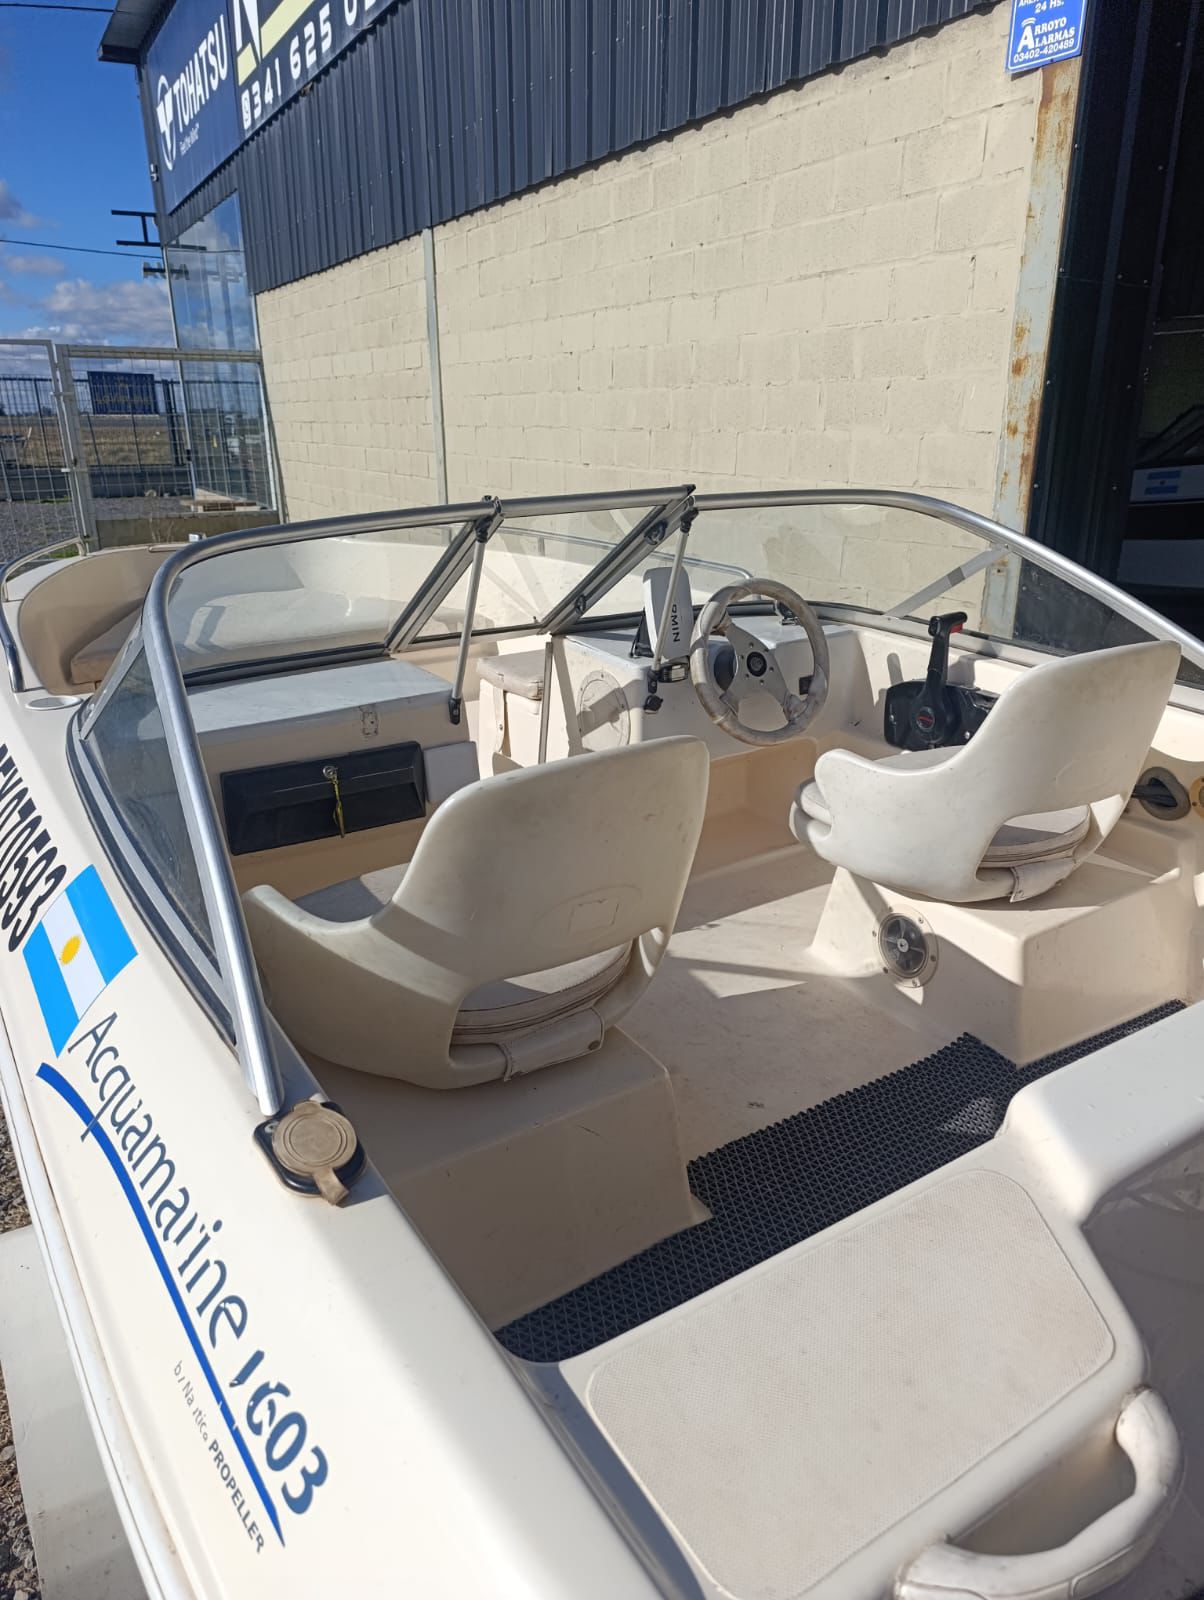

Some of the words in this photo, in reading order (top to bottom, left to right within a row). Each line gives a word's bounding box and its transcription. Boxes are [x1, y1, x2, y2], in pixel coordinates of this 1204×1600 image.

[289, 3, 332, 80] 625
[1034, 2, 1047, 14] 24
[173, 14, 228, 132] TOHATSU
[67, 1011, 248, 1350] Acquamarine
[228, 1350, 329, 1515] 1603
[208, 1439, 265, 1554] PROPELLER
